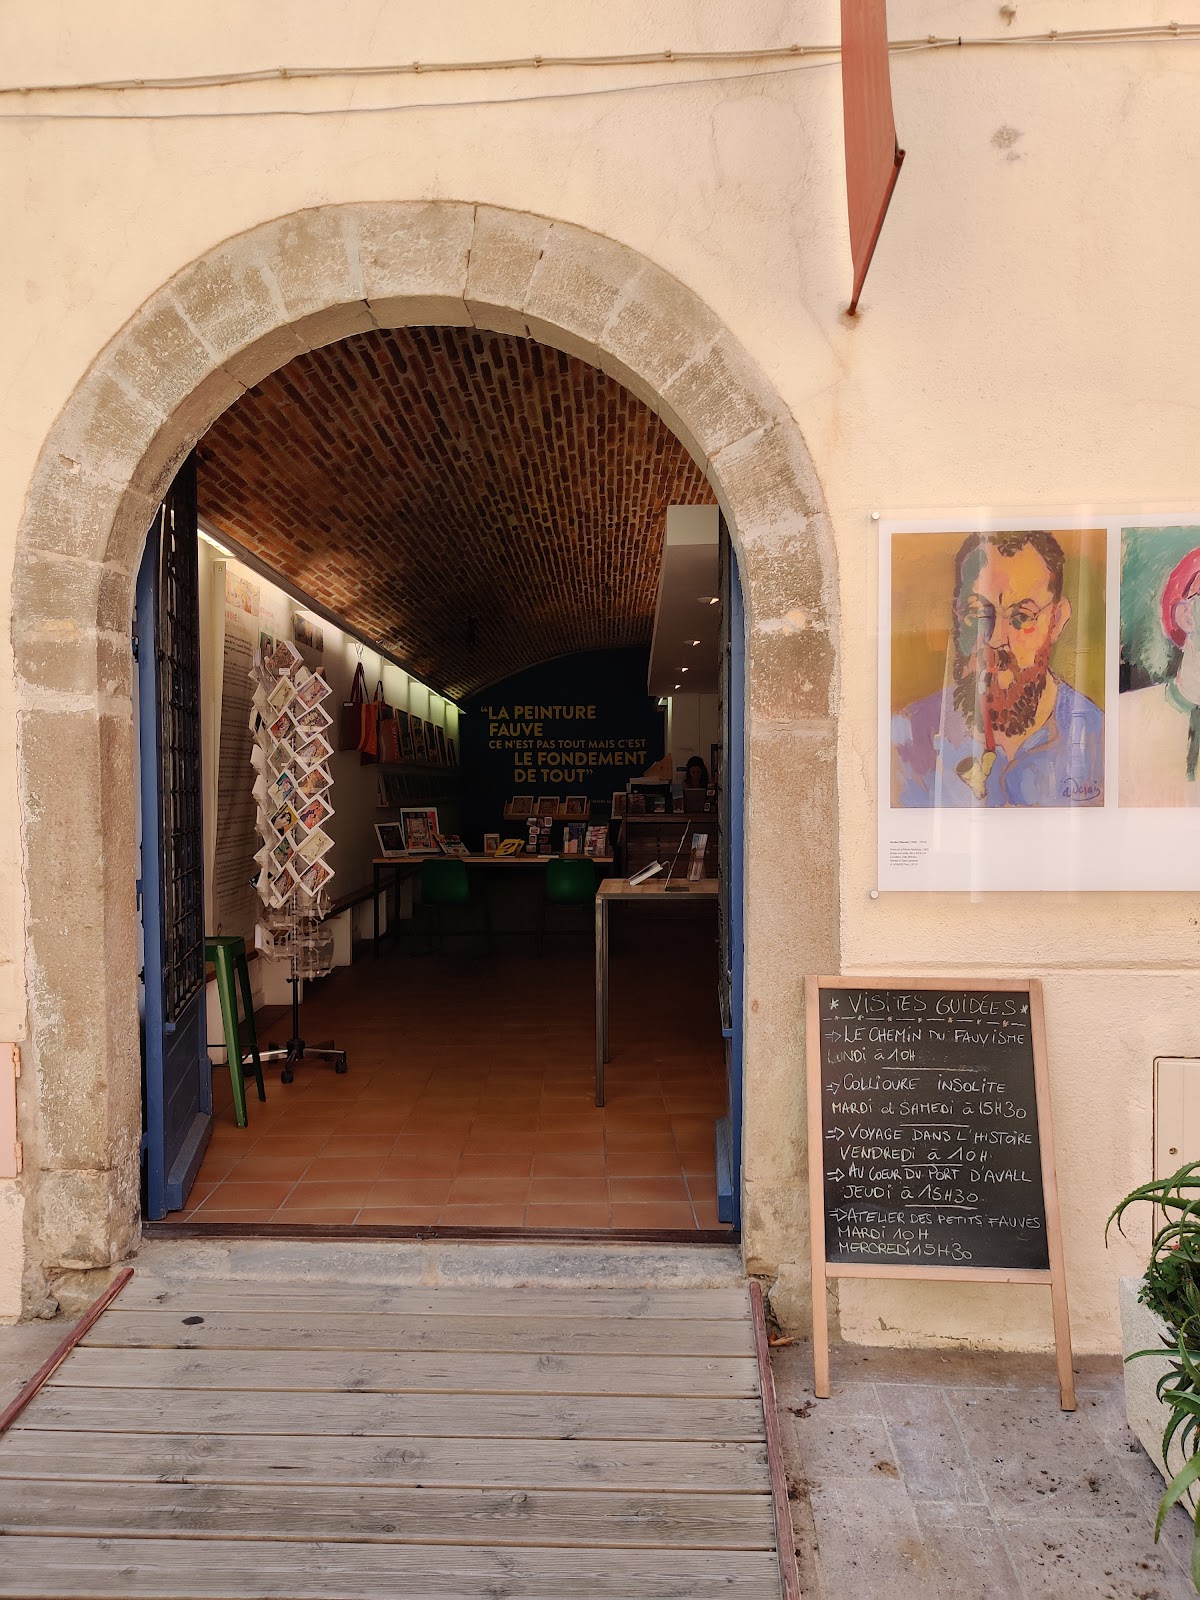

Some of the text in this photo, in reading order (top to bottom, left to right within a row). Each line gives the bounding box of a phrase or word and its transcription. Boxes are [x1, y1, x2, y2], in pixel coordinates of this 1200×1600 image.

[514, 705, 597, 720] PEINTURE
[489, 722, 544, 737] FAUVE
[488, 738, 647, 749] CE N'EST PAS TOUT MAIS C'EST
[514, 751, 647, 766] LE FONDEMENT
[514, 769, 537, 783] DE
[848, 991, 1016, 1016] VISITES GUIDÉES
[844, 1025, 1025, 1046] LE CHEMIN DU FAUVISME
[827, 1047, 867, 1064] LUNDI
[887, 1048, 916, 1062] 10H
[843, 1073, 1006, 1093] COLLIOURE INSOLITE
[832, 1098, 873, 1114] MARDI
[899, 1101, 954, 1116] SAMEDI
[979, 1101, 1027, 1119] 15H30
[848, 1124, 902, 1141] VOYAGE
[912, 1128, 951, 1142] DANS
[840, 1146, 916, 1162] VENDREDI
[849, 1161, 1032, 1183] AU COEUR DU PORT D'AVALL
[843, 1184, 892, 1200] JEUDI
[918, 1183, 979, 1203] 15H30
[847, 1207, 1041, 1229] ATELIER DES PETITS FAUVES
[838, 1226, 886, 1240] MARDI
[838, 1240, 973, 1261] MERCREDI 15H30
